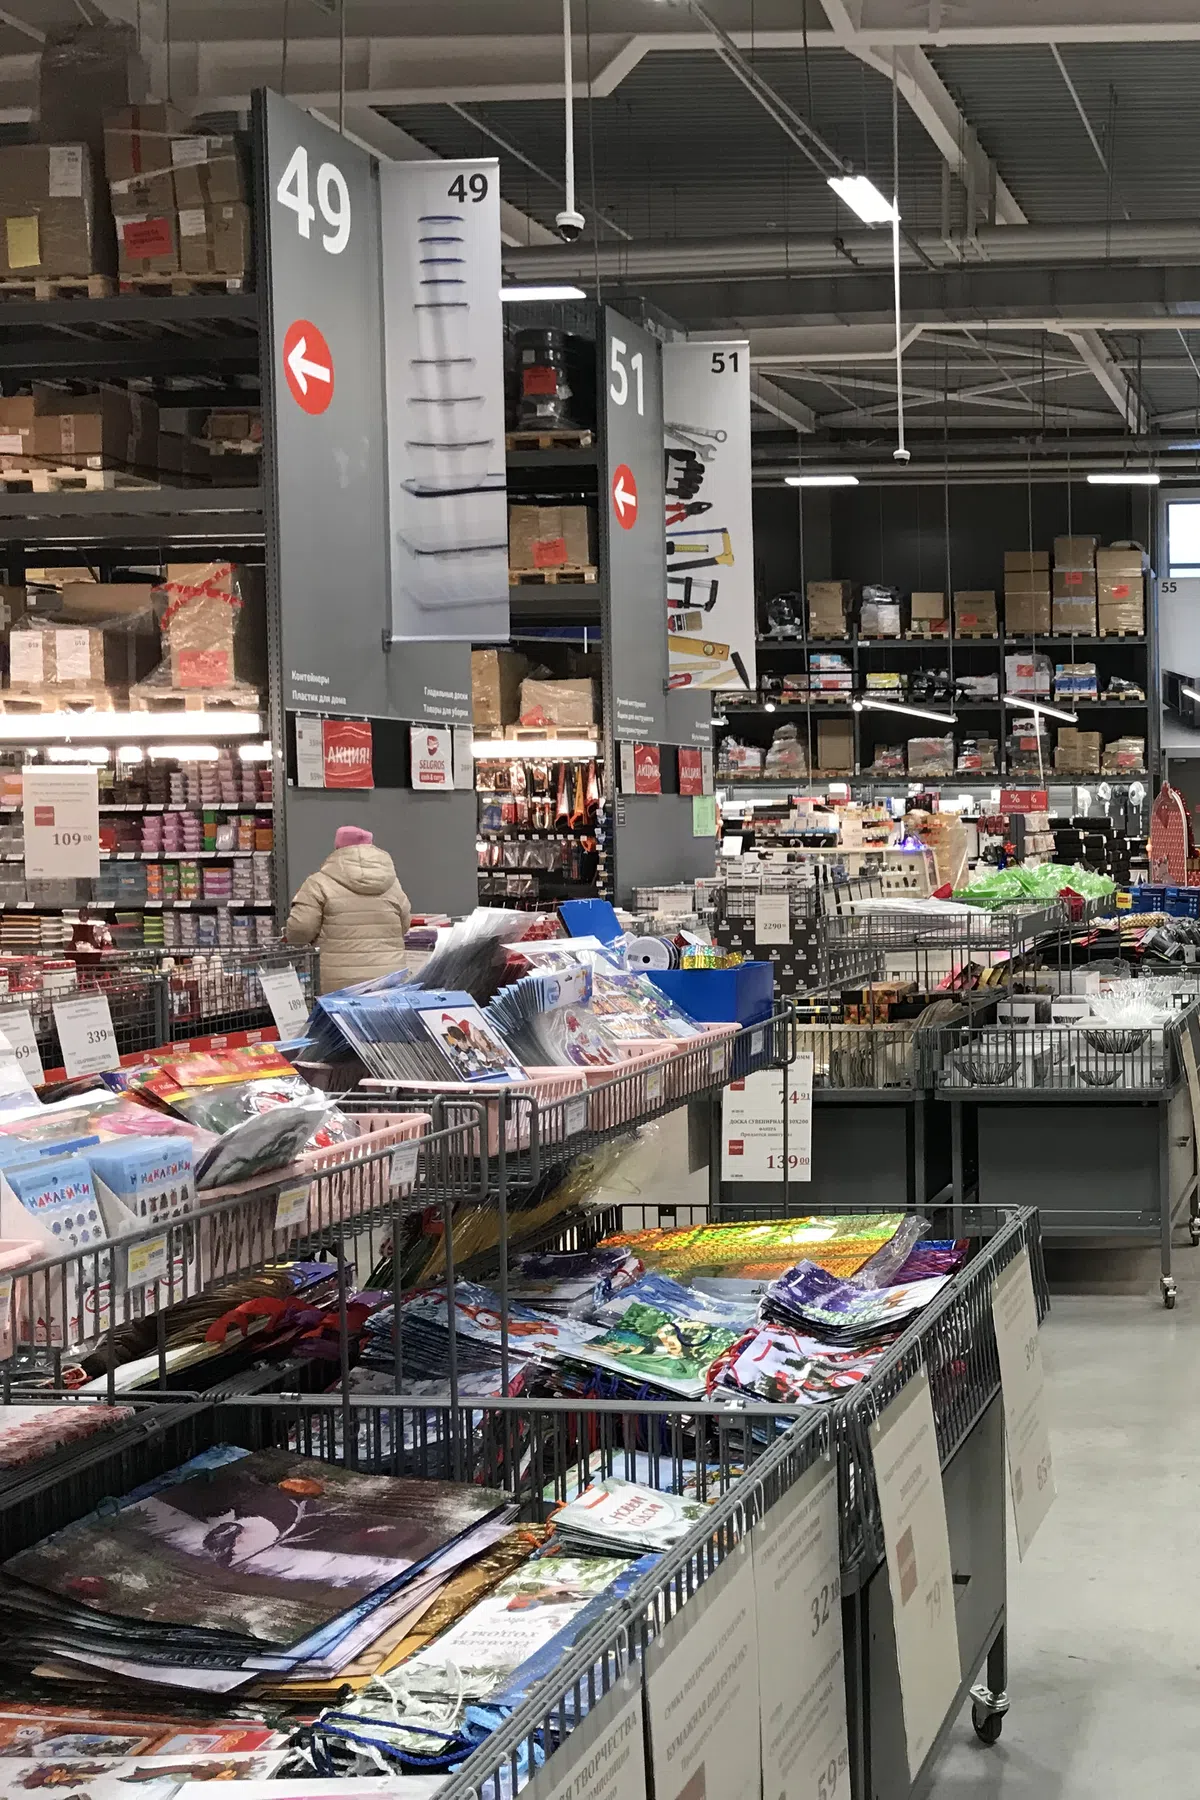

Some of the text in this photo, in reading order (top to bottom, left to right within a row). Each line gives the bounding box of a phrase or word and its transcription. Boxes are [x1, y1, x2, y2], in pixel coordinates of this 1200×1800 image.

[447, 173, 489, 203] 49
[277, 145, 351, 255] 49
[711, 352, 739, 373] 51
[610, 336, 644, 416] 51
[1161, 581, 1178, 594] 55
[291, 670, 330, 686] Контейнеры
[292, 690, 347, 706] Пластик для дома
[423, 704, 442, 717] Товары
[442, 707, 452, 716] для
[327, 746, 370, 767] АКЦИЯ!
[419, 760, 445, 770] SELGROS
[53, 833, 82, 846] 109
[763, 922, 782, 931] 2290
[87, 1029, 107, 1044] 339
[141, 1159, 191, 1184] НАКЛЕЙКИ
[767, 1155, 798, 1169] 139
[28, 1182, 90, 1209] НАКЛЕЙКИ
[609, 1495, 648, 1520] НОВЫМ
[811, 1585, 830, 1638] 32
[667, 1703, 708, 1763] БУМАЖНАЯ
[574, 1710, 638, 1796] ТВОРЧЕСТВА
